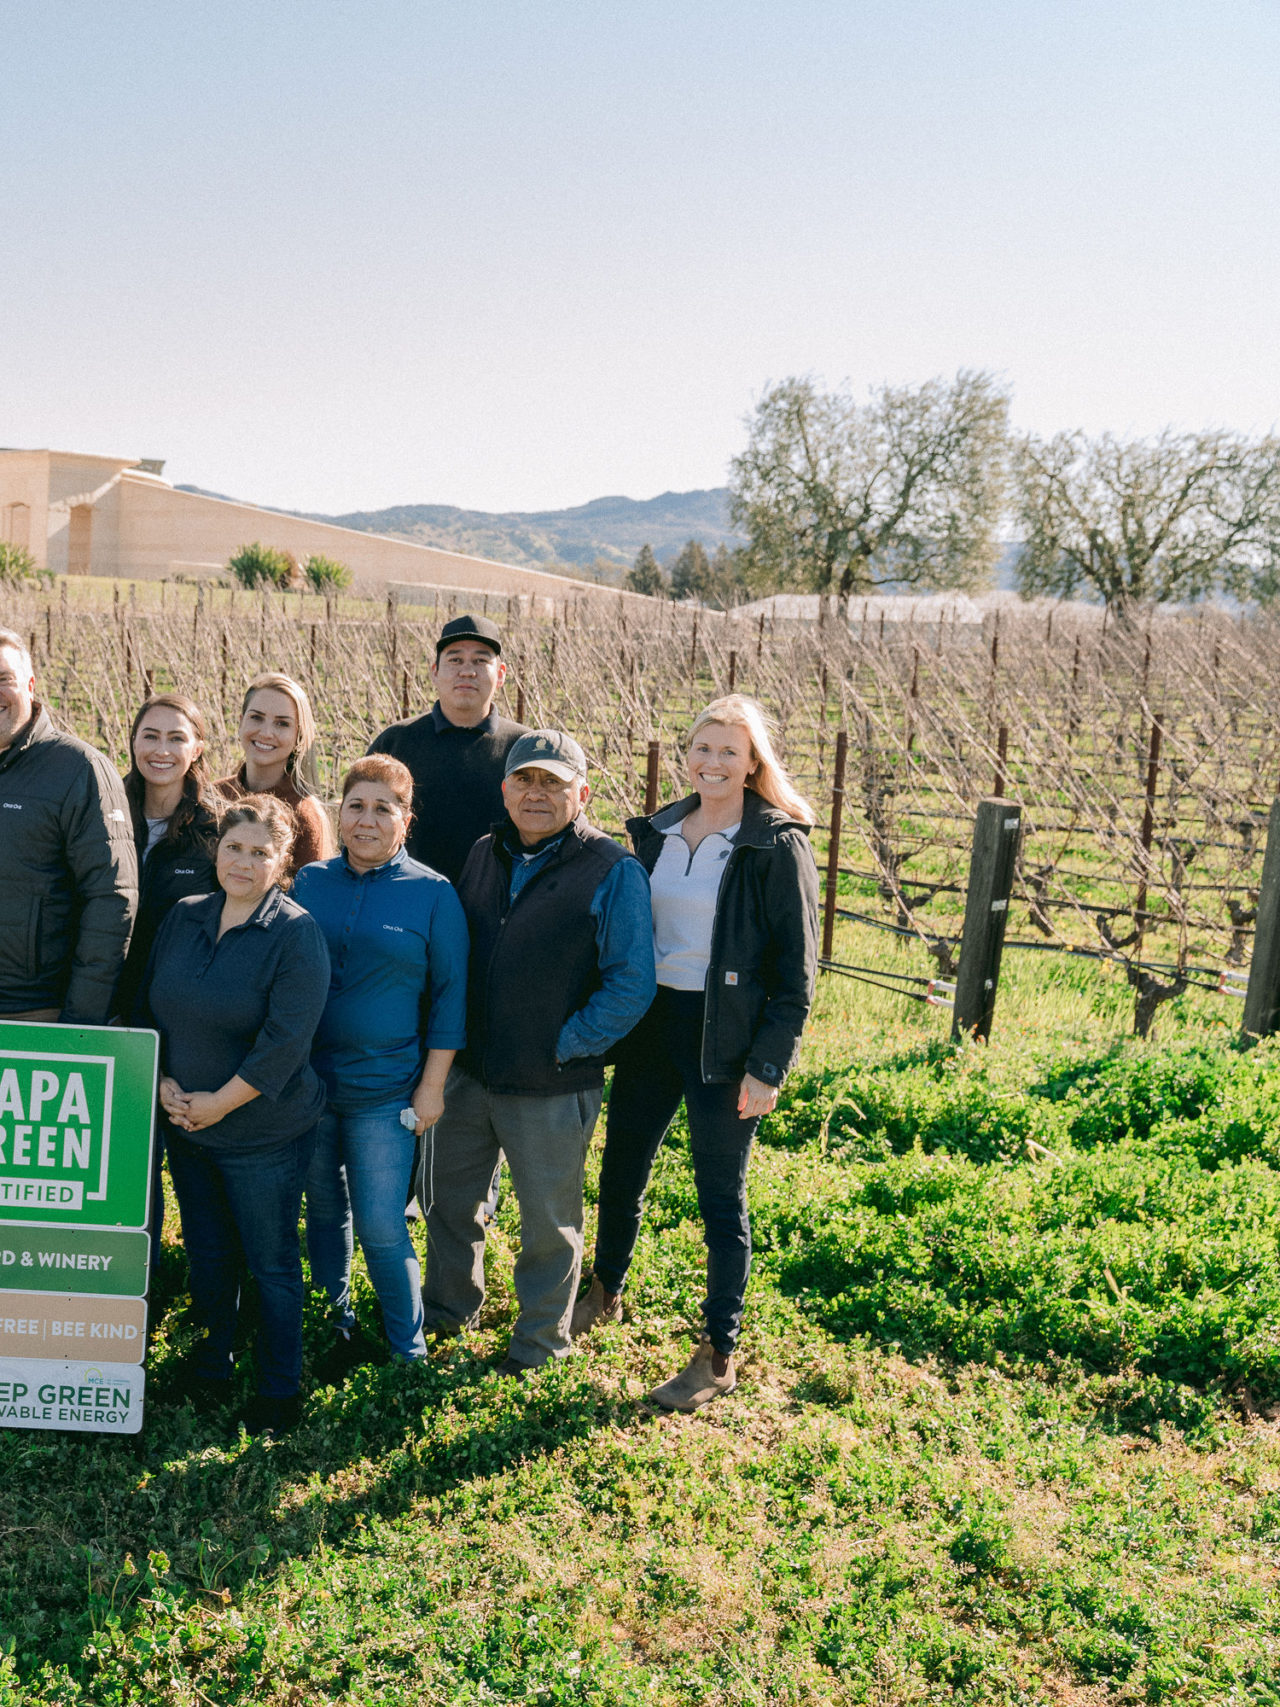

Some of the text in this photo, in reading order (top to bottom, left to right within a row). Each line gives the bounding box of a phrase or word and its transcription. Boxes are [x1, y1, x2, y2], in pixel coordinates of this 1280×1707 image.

[20, 1251, 34, 1267] &
[38, 1252, 113, 1271] WINERY
[51, 1321, 87, 1337] BEE
[90, 1322, 138, 1340] KIND
[37, 1384, 131, 1409] GREEN
[59, 1408, 129, 1424] ENERGY
